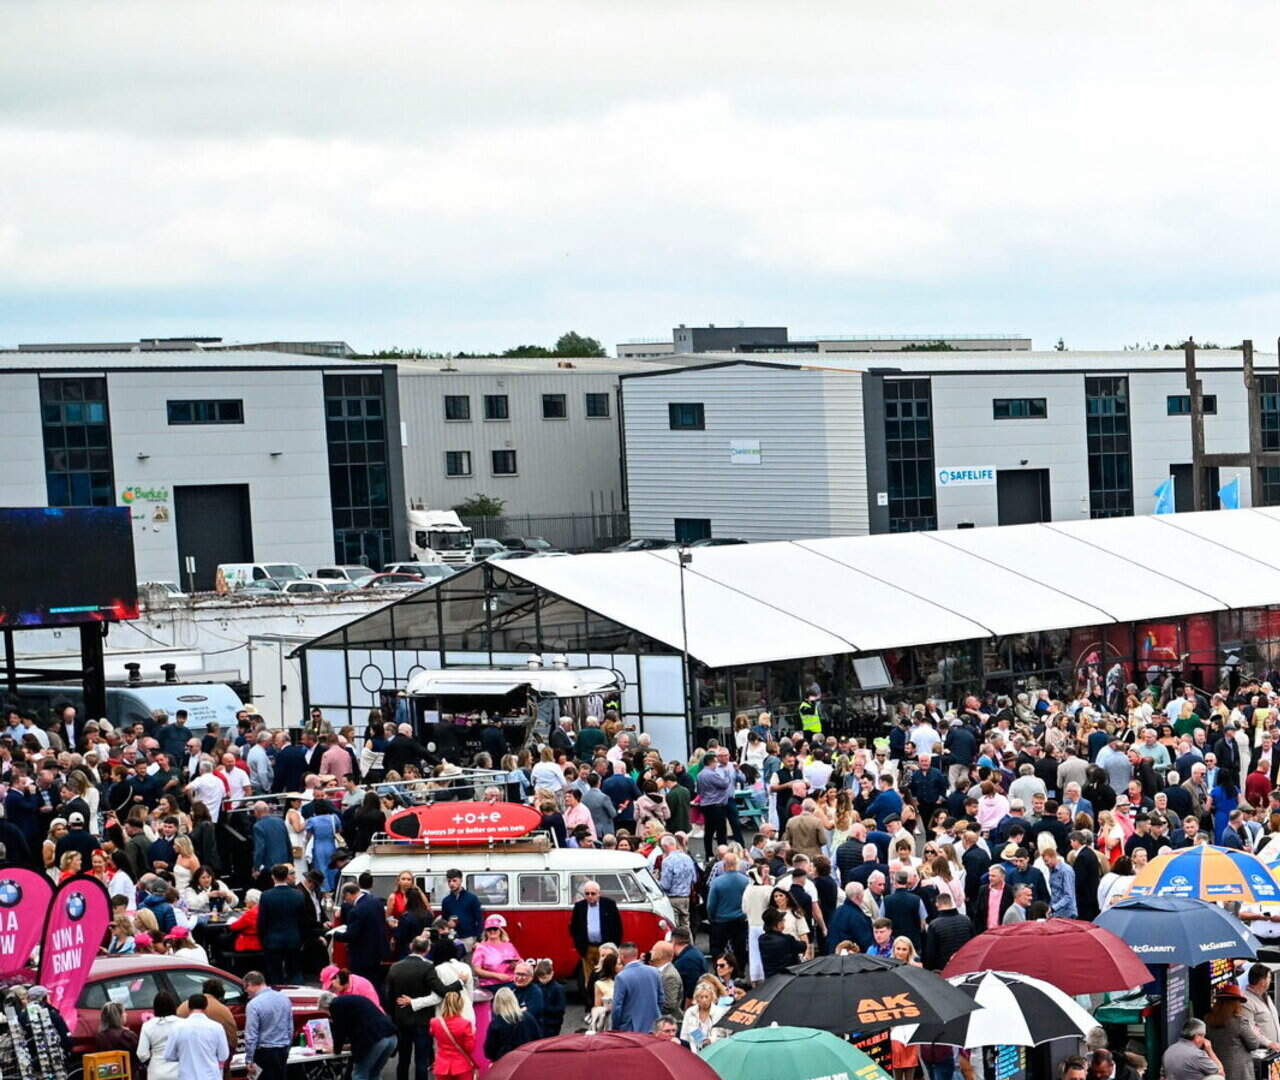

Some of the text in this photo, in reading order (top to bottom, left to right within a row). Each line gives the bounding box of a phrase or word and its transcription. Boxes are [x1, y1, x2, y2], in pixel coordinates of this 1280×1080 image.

[950, 469, 993, 481] SAFELIFE
[52, 948, 82, 974] BMW
[738, 998, 769, 1015] AK
[856, 992, 915, 1014] AK
[728, 1011, 758, 1025] BETS
[857, 1006, 921, 1024] BETS
